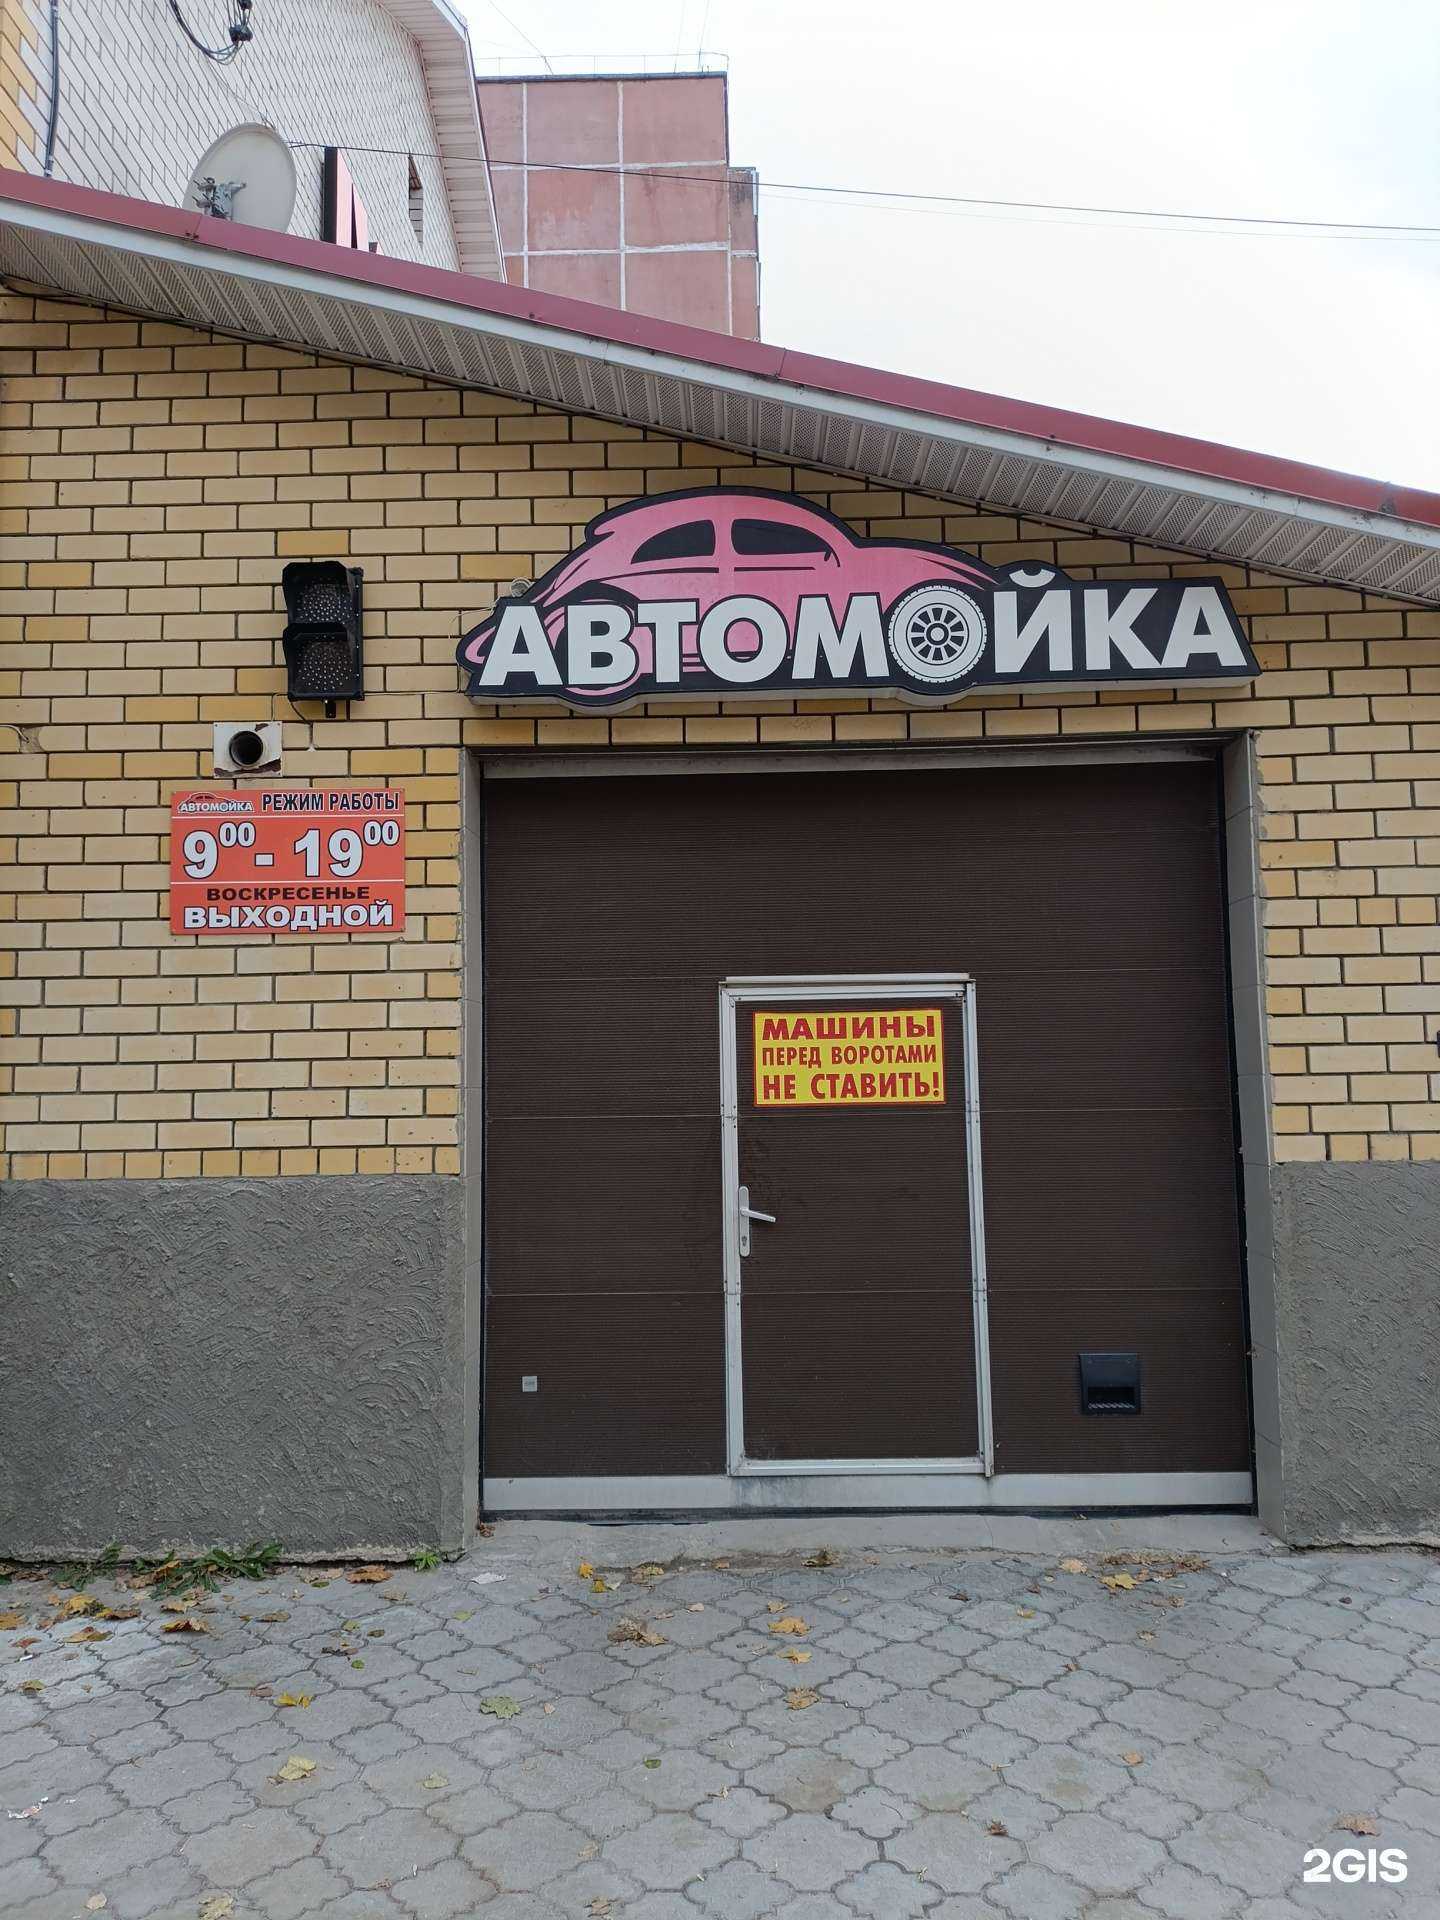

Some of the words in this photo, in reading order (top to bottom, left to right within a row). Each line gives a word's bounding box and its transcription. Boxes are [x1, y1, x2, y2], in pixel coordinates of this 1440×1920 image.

[479, 568, 1247, 687] АВТОМОЙКА
[179, 801, 253, 813] АВТОМОЙКА
[262, 793, 323, 811] РЕЖИМ
[329, 792, 399, 810] РАБОТЫ
[206, 887, 370, 901] ВОСКРЕСЕНЬЕ
[183, 899, 393, 931] ВЫХОДНОЙ
[762, 1016, 935, 1040] МАШИНЫ
[762, 1047, 822, 1068] ПЕРЕД
[831, 1044, 937, 1064] ВОРОТАМИ
[763, 1075, 797, 1099] НЕ
[810, 1072, 940, 1099] СТАВИТЬ!
